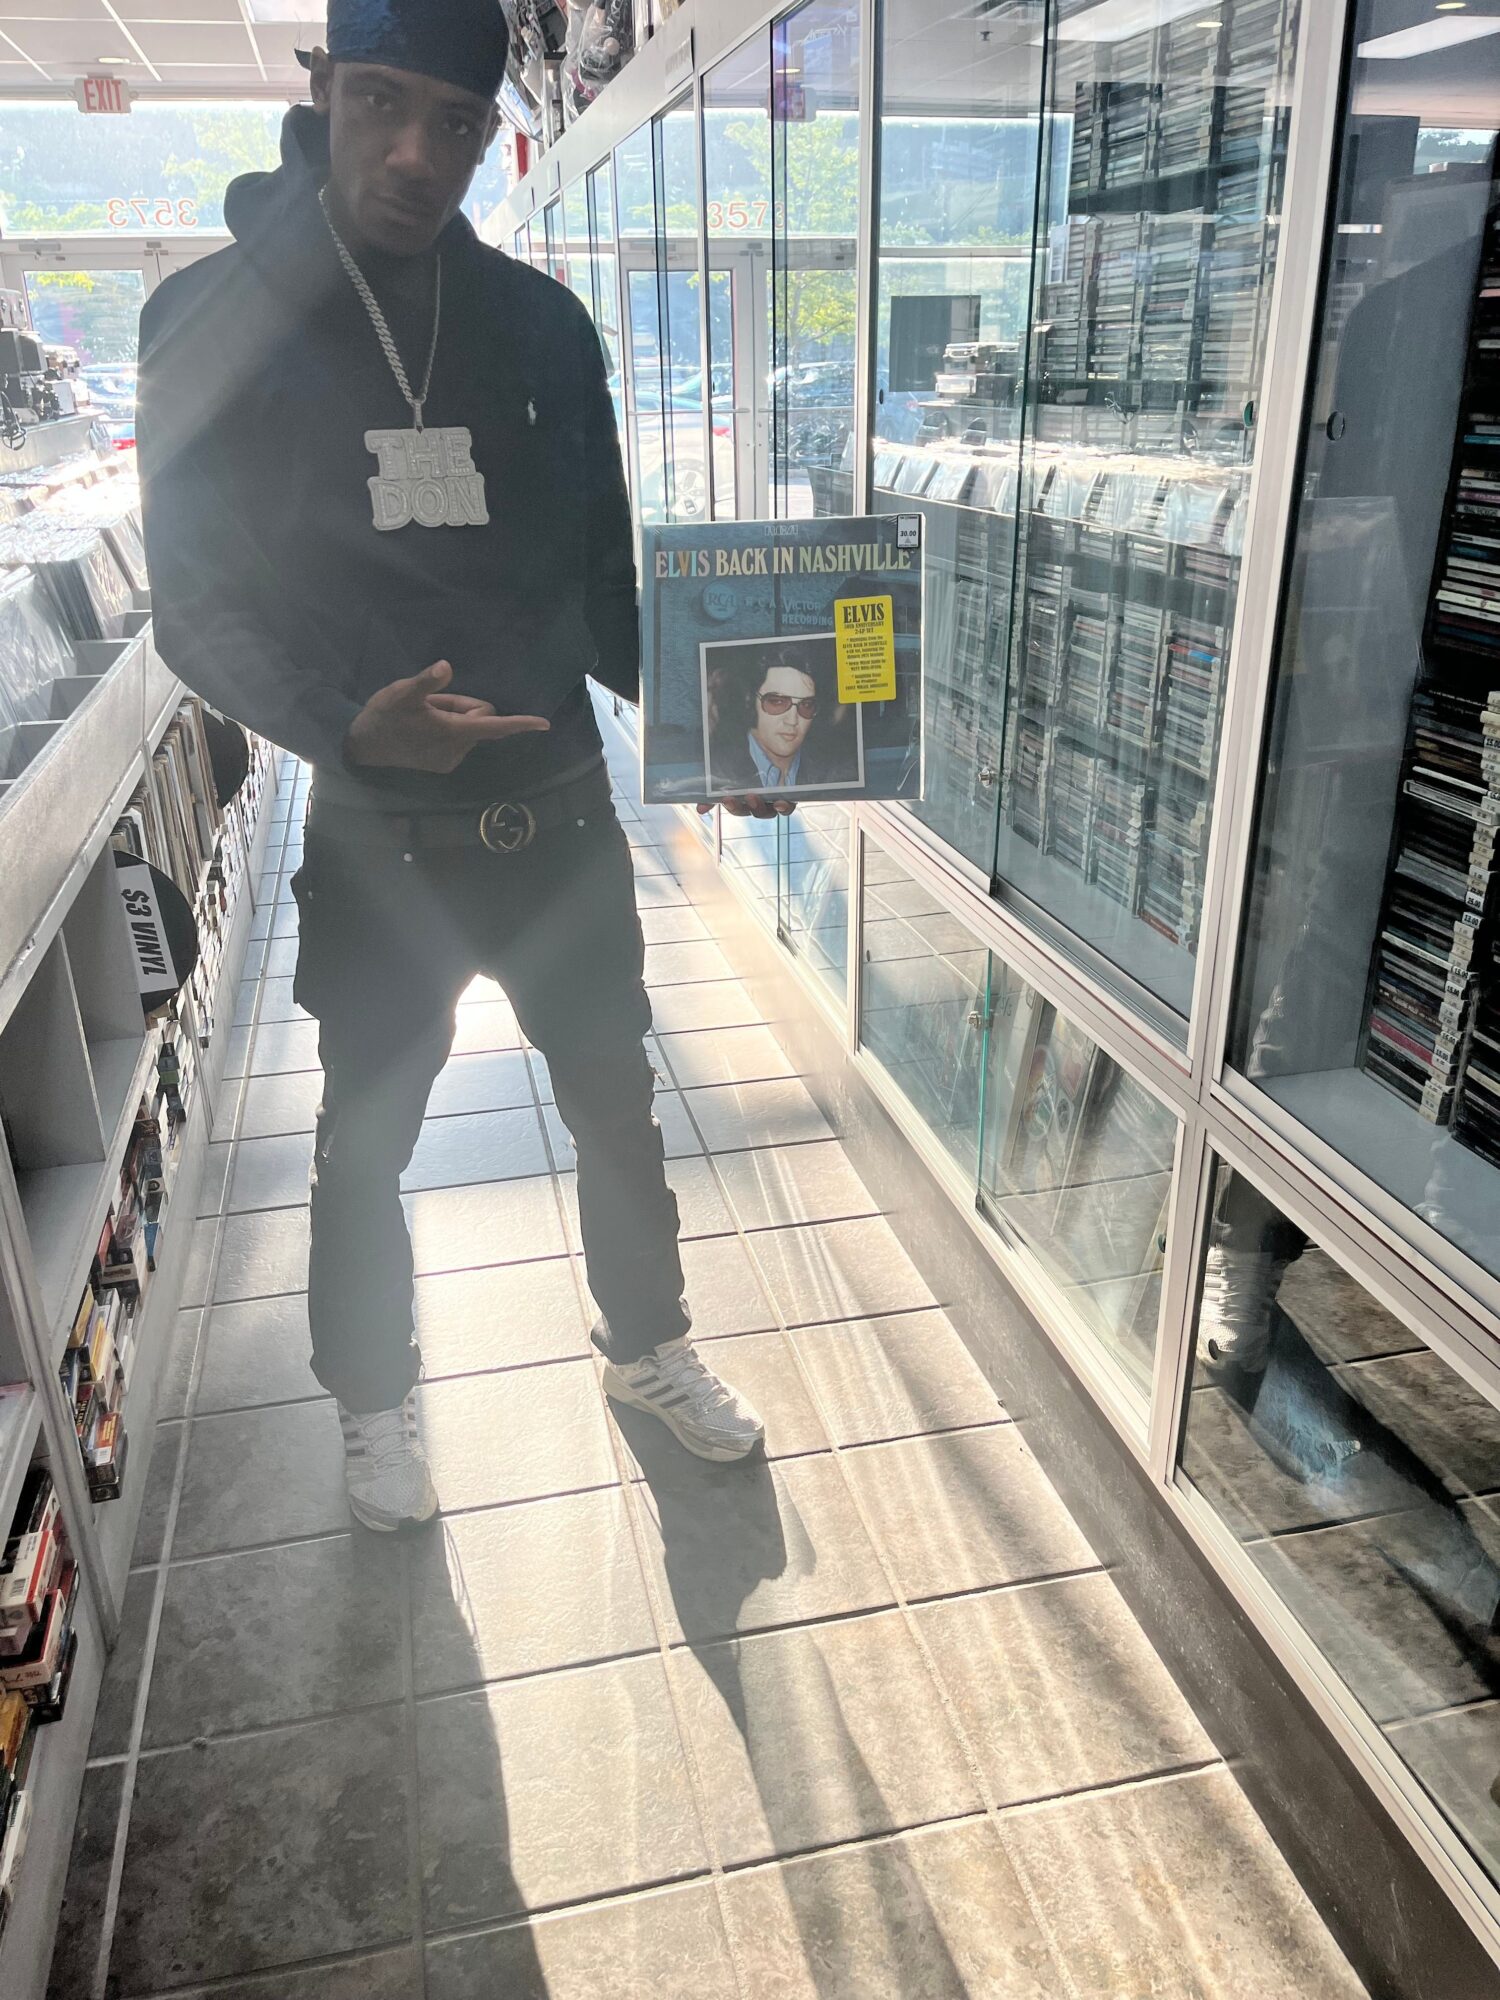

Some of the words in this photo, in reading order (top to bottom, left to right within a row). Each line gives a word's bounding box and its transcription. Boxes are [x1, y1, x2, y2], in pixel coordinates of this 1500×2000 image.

[83, 79, 122, 111] EXIT
[364, 427, 476, 480] THE
[367, 473, 489, 530] DON
[655, 550, 710, 578] ELVIS
[715, 548, 768, 576] BACK
[773, 546, 794, 574] IN
[799, 543, 911, 573] NASHVILLE
[781, 614, 833, 626] RECORDING
[843, 603, 884, 623] ELVIS
[121, 889, 152, 917] $3
[131, 922, 168, 975] VINYL
